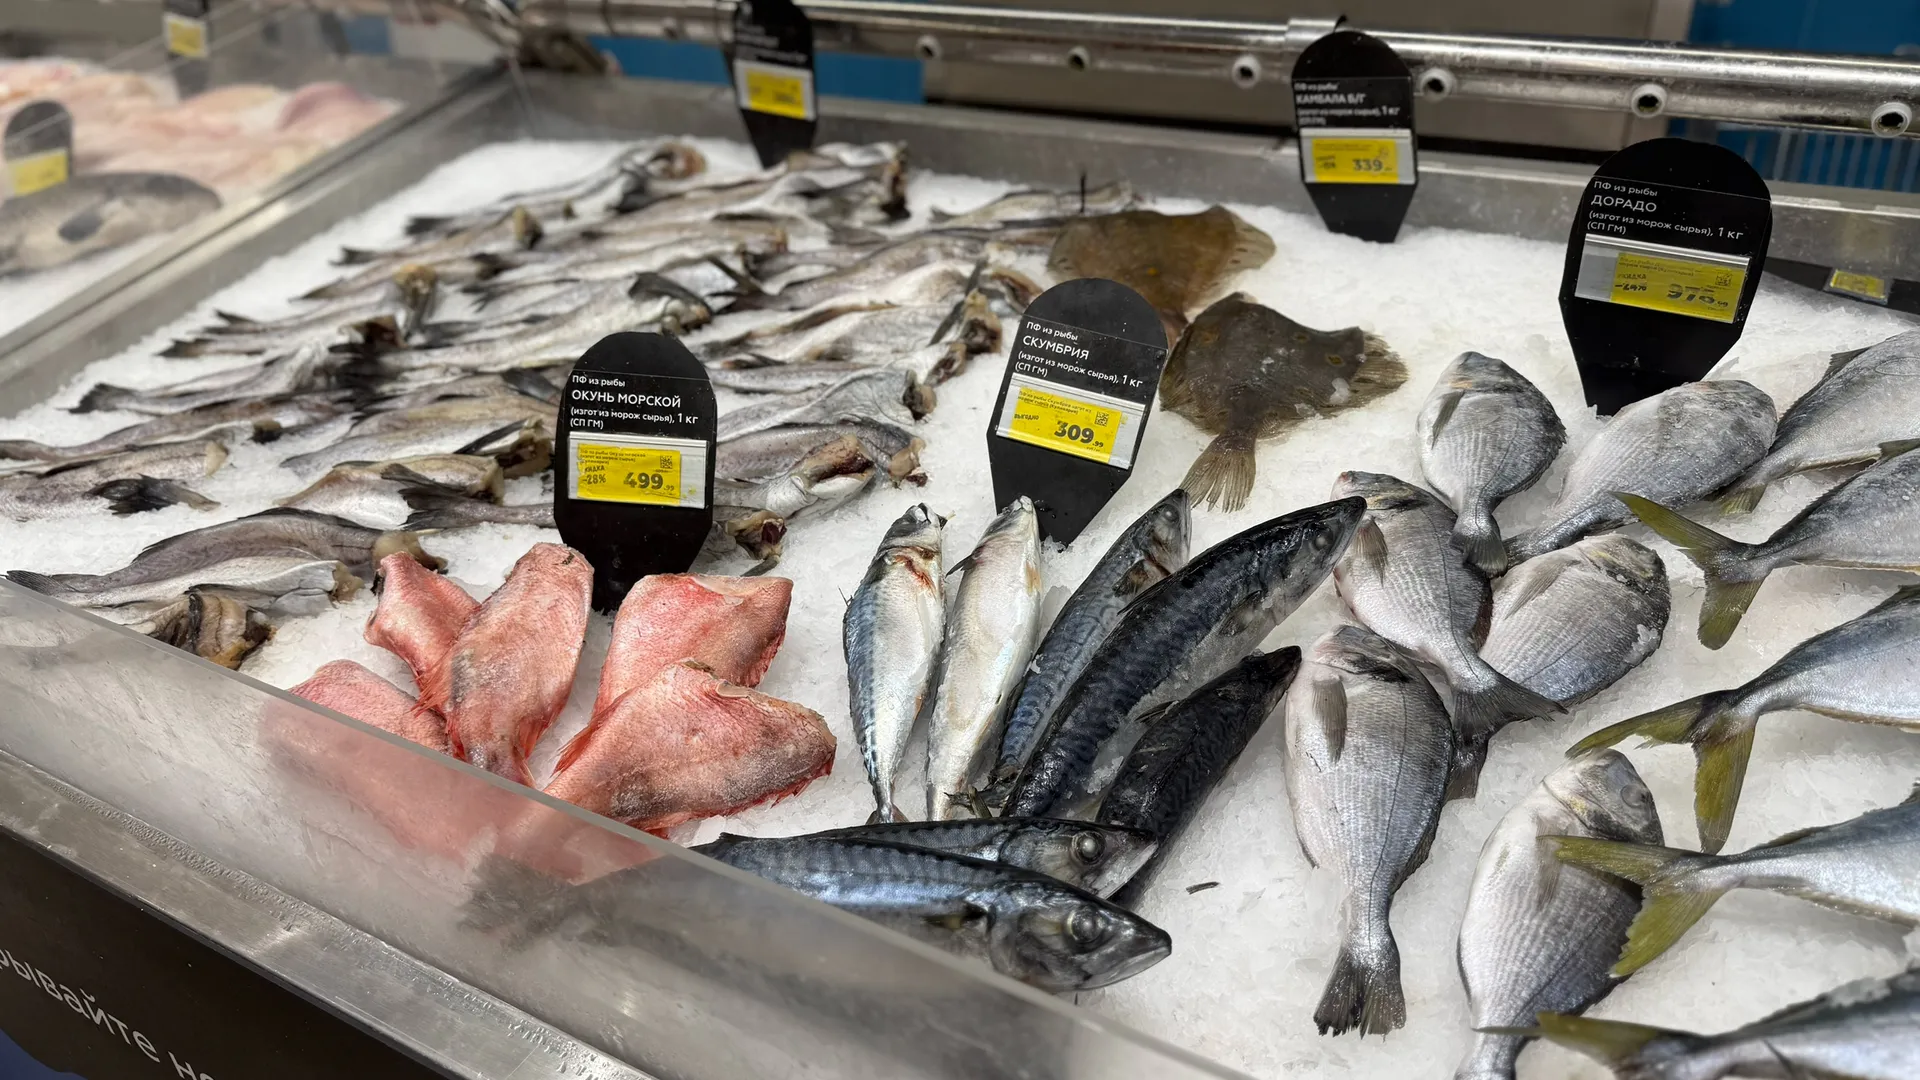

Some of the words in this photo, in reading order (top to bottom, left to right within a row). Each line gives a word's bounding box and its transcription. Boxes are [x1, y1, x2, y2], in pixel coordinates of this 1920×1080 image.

[1296, 93, 1346, 104] КАМБАЛА
[1594, 181, 1611, 190] ПФ
[1628, 187, 1658, 197] рыбы
[1591, 195, 1657, 212] ДОРАДО
[1587, 221, 1605, 231] (СП
[1607, 224, 1626, 234] ГМ)
[1589, 210, 1621, 222] (изгот
[1637, 219, 1671, 230] морож
[1674, 224, 1714, 237] сырья),
[1718, 227, 1724, 237] 1
[1727, 231, 1744, 240] кг
[1026, 321, 1041, 332] ПФ
[1042, 326, 1052, 334] из
[1054, 328, 1078, 341] рыбы
[1023, 336, 1089, 360] СКУМБРИЯ
[1015, 361, 1030, 372] (СП
[1032, 365, 1048, 377] ГМ)
[1018, 351, 1044, 364] (изгот
[1057, 361, 1086, 374] морож
[1087, 369, 1119, 384] сырья),
[1122, 374, 1127, 385] 1
[1129, 378, 1143, 388] кг
[572, 375, 587, 383] ПФ
[601, 378, 625, 387] рыбы
[572, 390, 614, 402] ОКУНЬ
[618, 394, 681, 408] МОРСКОЙ
[570, 406, 597, 416] (изгот
[611, 411, 640, 420] морож
[643, 414, 675, 423] сырья),
[677, 413, 682, 422] 1
[686, 416, 698, 424] кг
[570, 418, 586, 427] (СП
[587, 420, 604, 429] ГМ)
[1054, 420, 1094, 443] 309
[582, 474, 606, 485] -28%
[623, 472, 664, 490] 499
[168, 1050, 214, 1080] н
